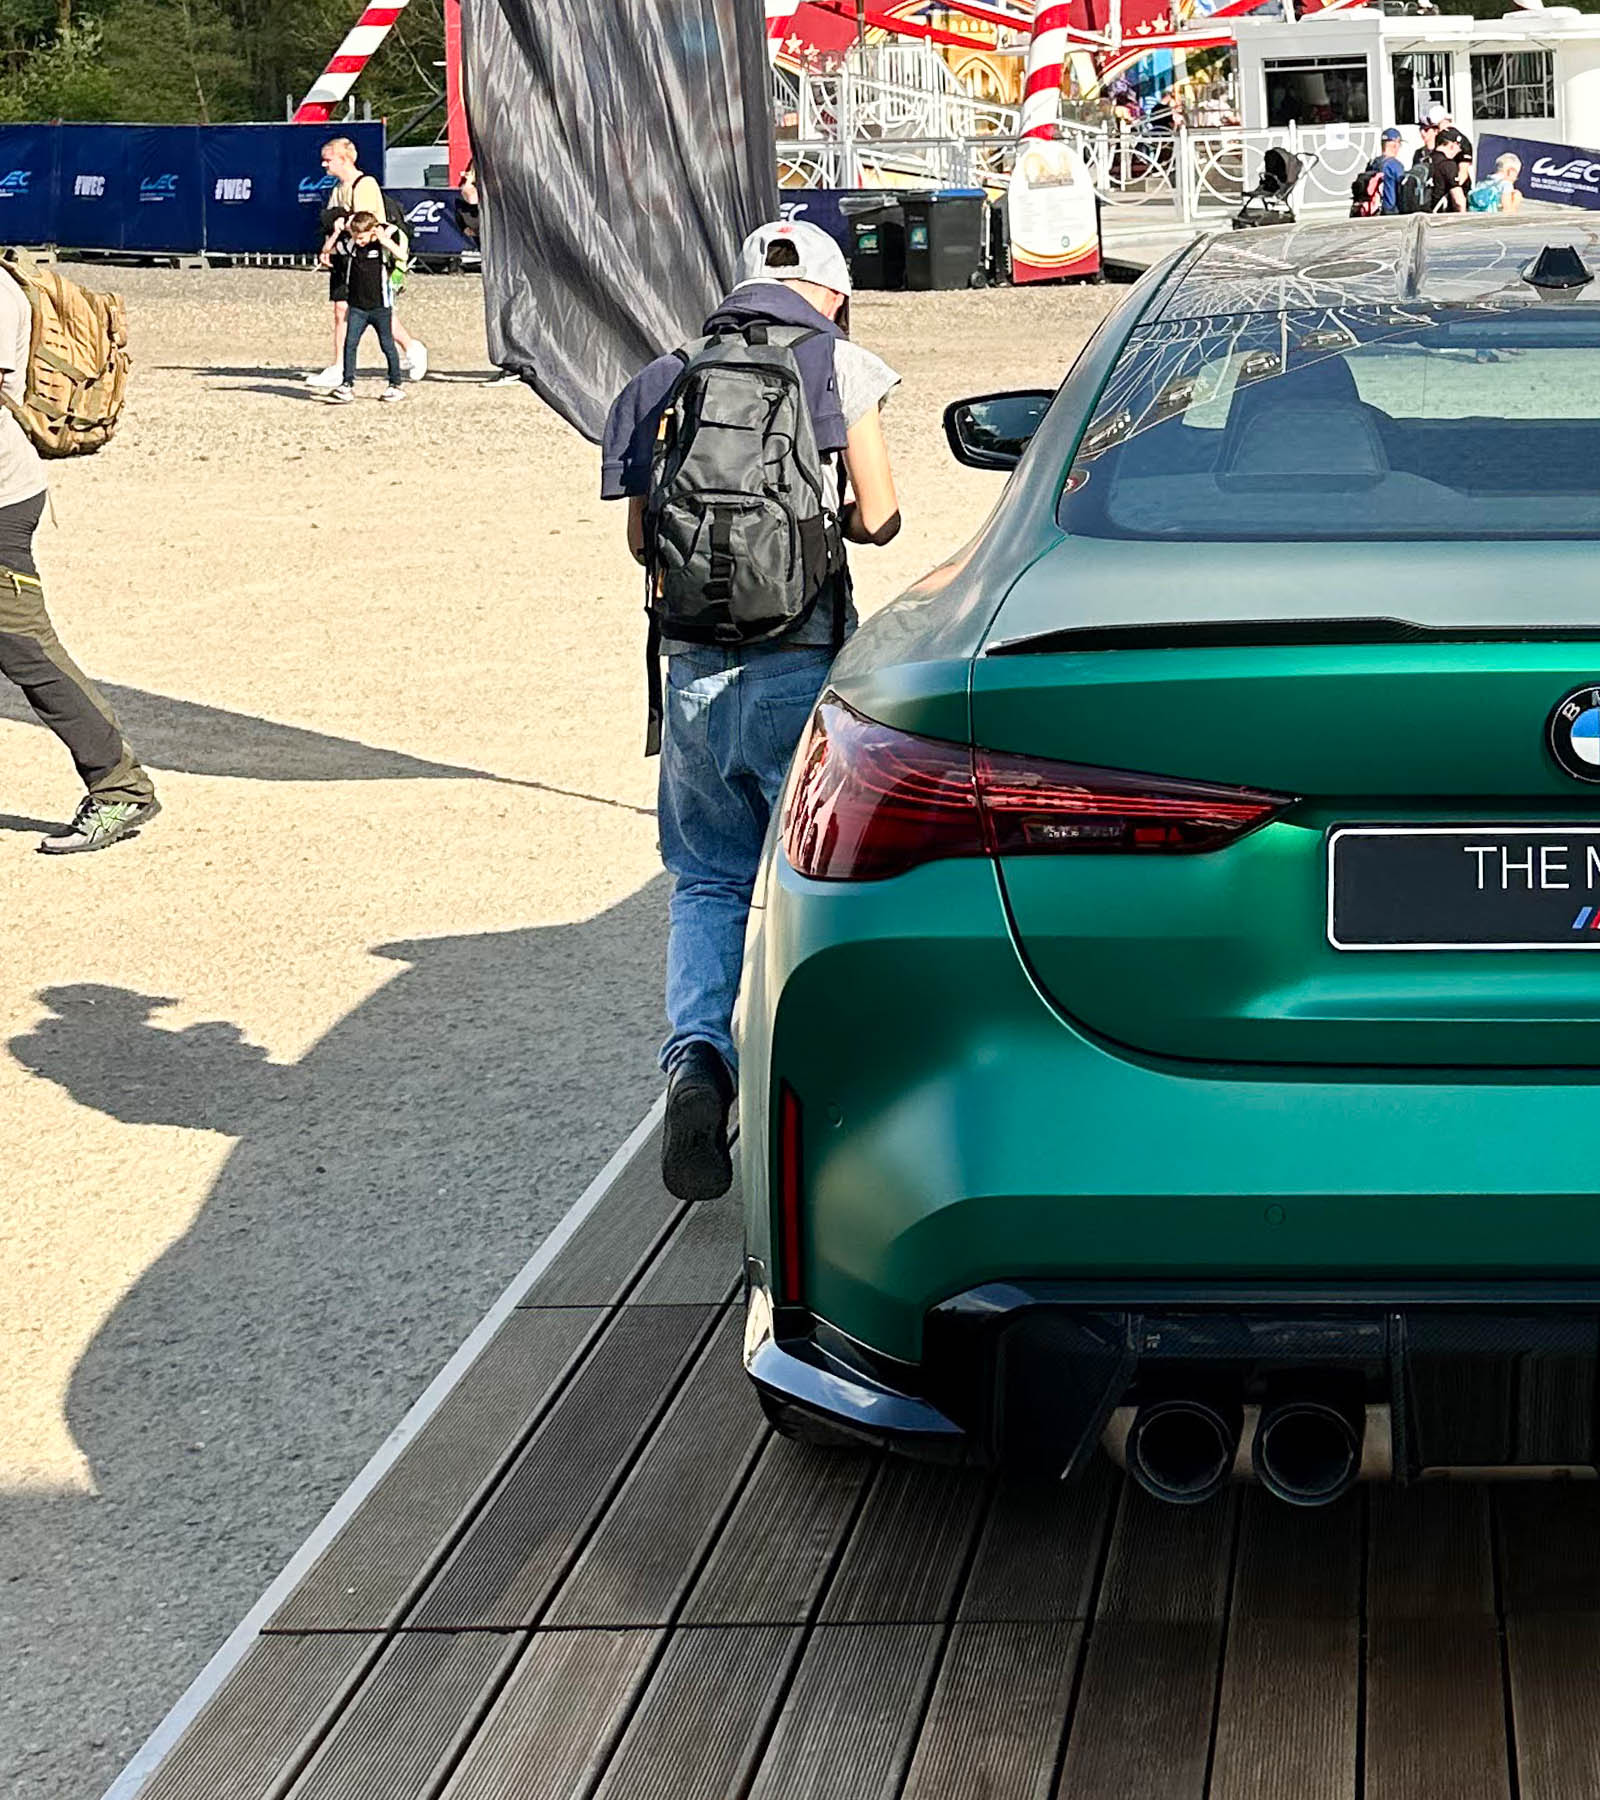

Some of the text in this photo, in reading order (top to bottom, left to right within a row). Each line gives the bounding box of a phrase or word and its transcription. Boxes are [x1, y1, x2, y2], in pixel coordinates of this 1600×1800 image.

[74, 175, 105, 196] #WEC
[140, 174, 179, 190] WEC
[215, 178, 252, 200] #WEC
[404, 200, 446, 223] EC
[1464, 846, 1569, 889] THE
